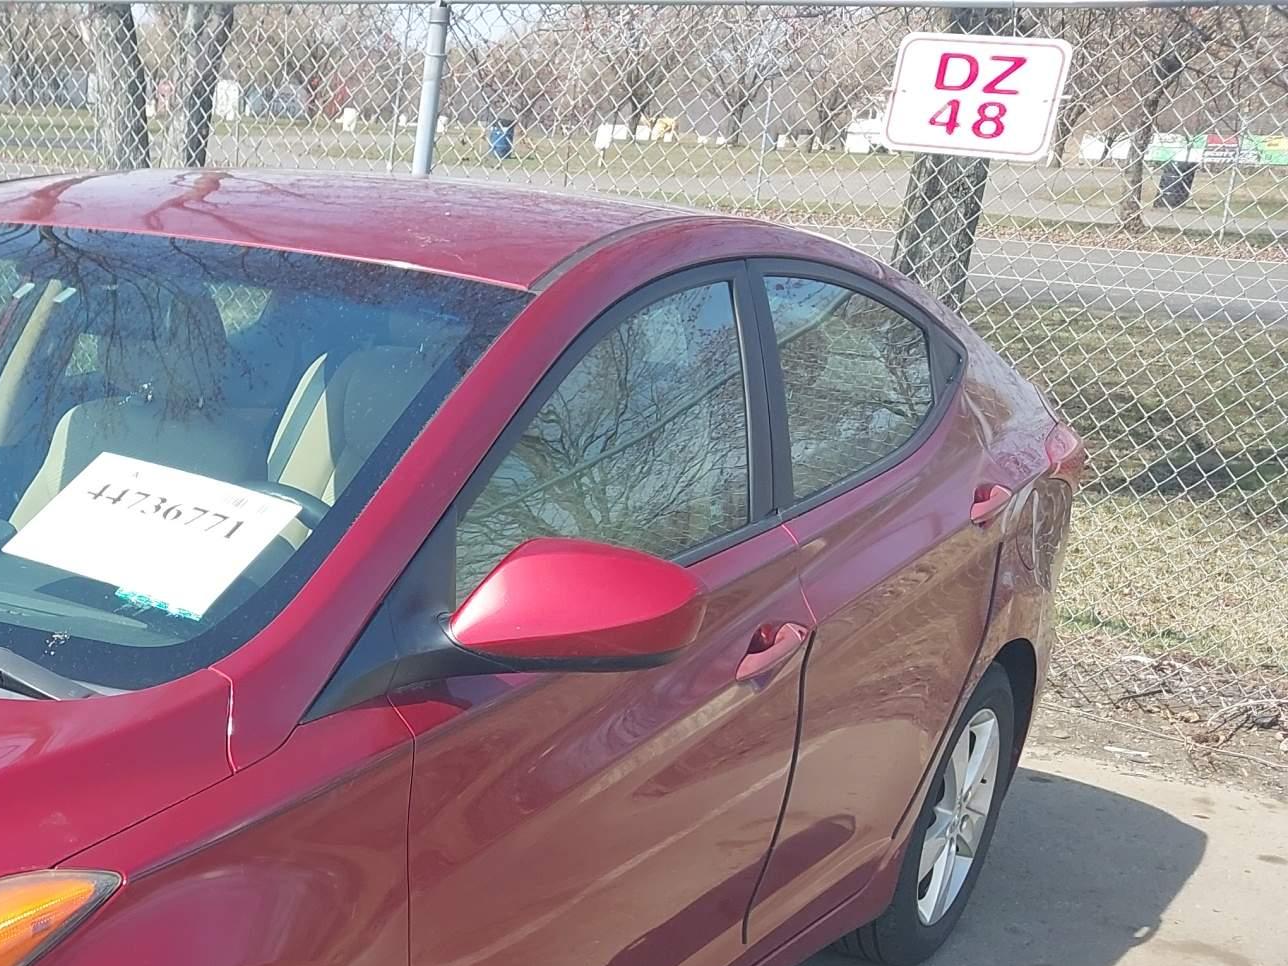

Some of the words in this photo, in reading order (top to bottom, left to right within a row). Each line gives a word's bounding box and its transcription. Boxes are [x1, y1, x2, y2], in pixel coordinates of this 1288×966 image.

[934, 52, 1028, 95] DZ
[928, 98, 1007, 139] 48
[87, 483, 245, 540] 44736771
